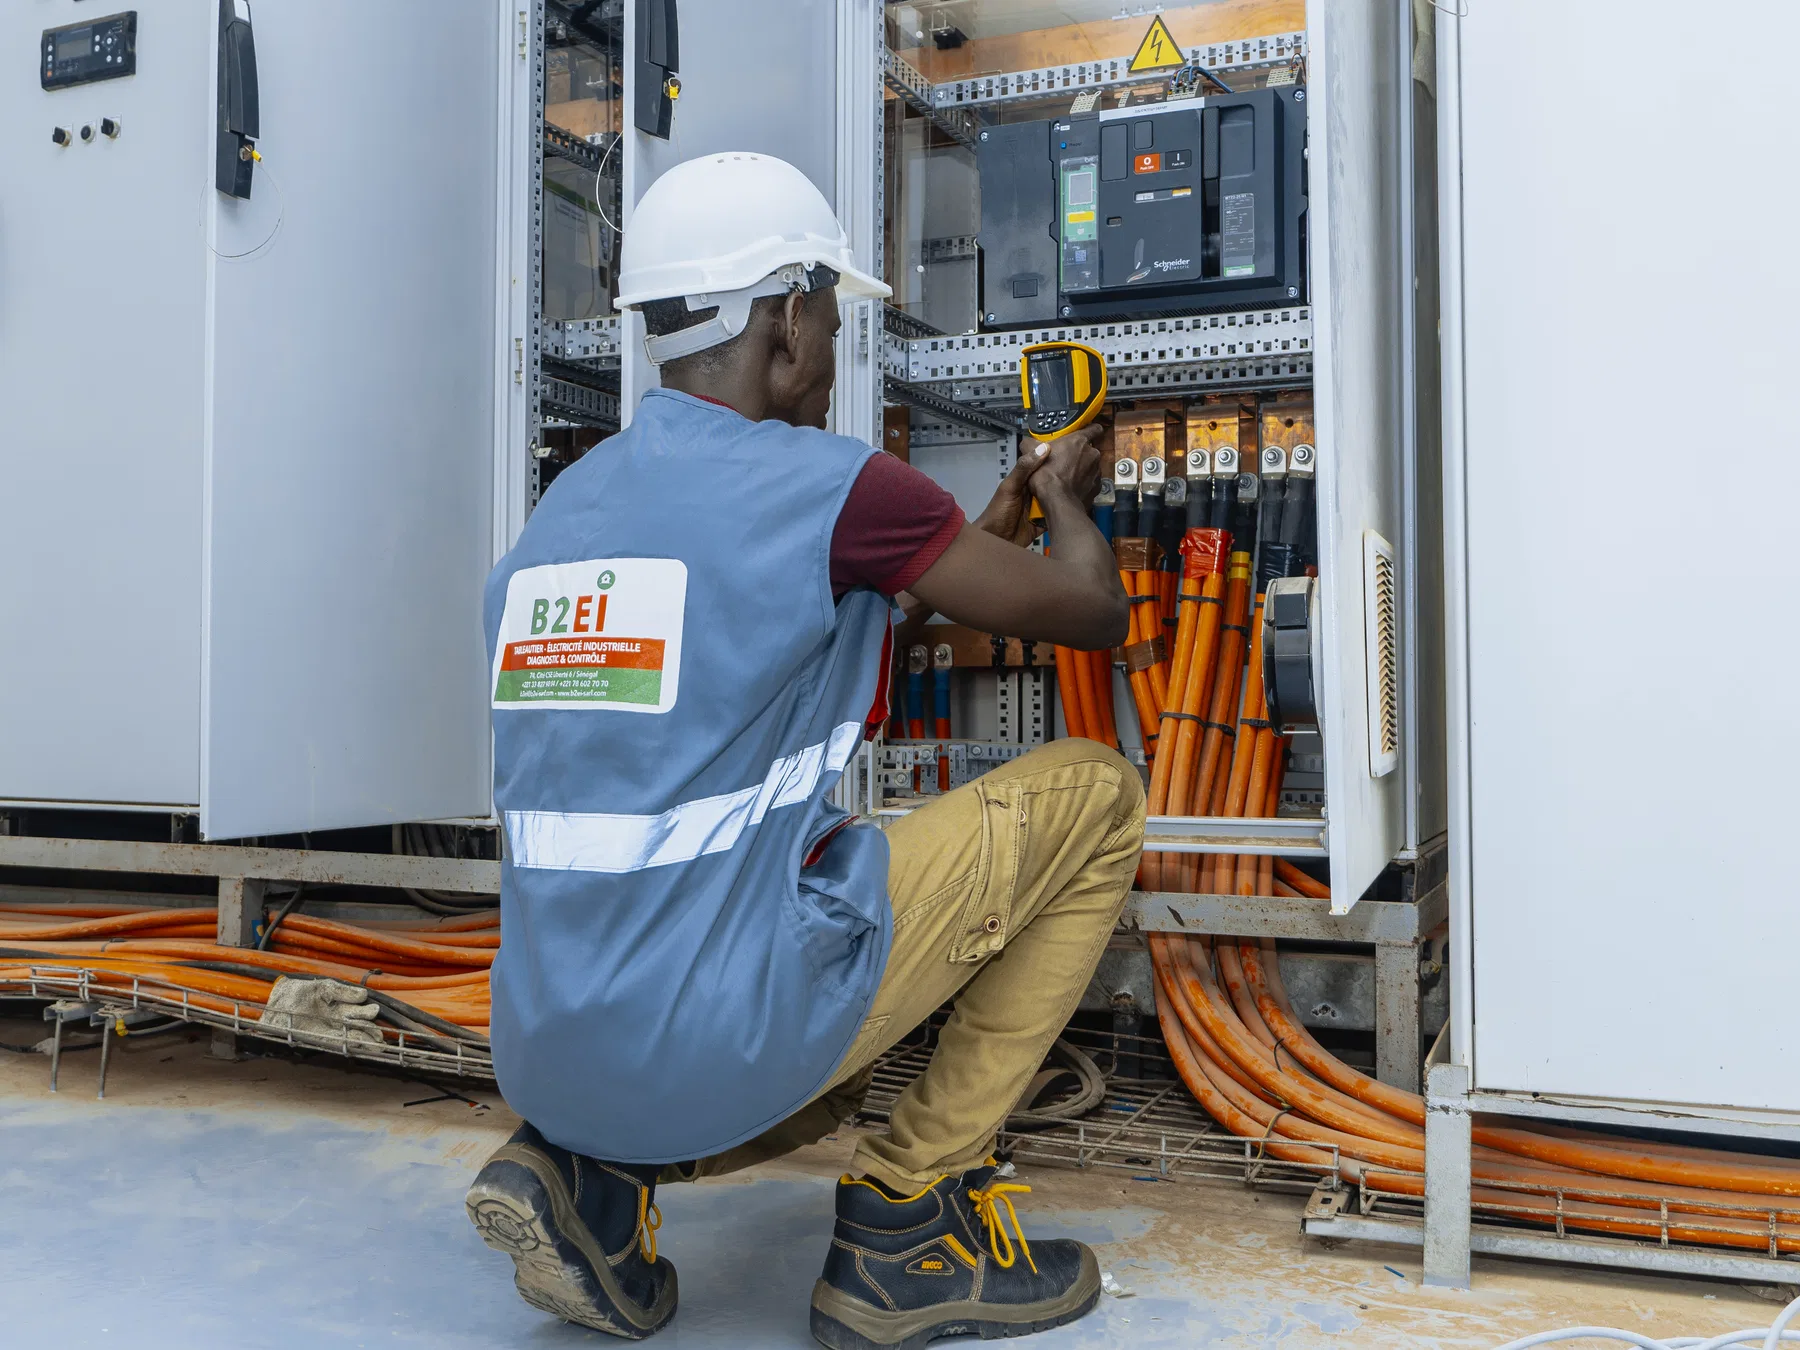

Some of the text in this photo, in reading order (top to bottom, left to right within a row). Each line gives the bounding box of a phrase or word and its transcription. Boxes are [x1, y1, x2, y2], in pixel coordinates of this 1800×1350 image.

[1153, 258, 1190, 272] Schneider
[514, 643, 544, 655] TABLEAUTIER
[547, 640, 583, 653] ÉLECTRICITÉ
[583, 641, 641, 653] INDUSTRIELLE
[526, 652, 607, 666] DIAGNOSTIC & CONTRÔLE
[576, 670, 598, 679] Sénégal
